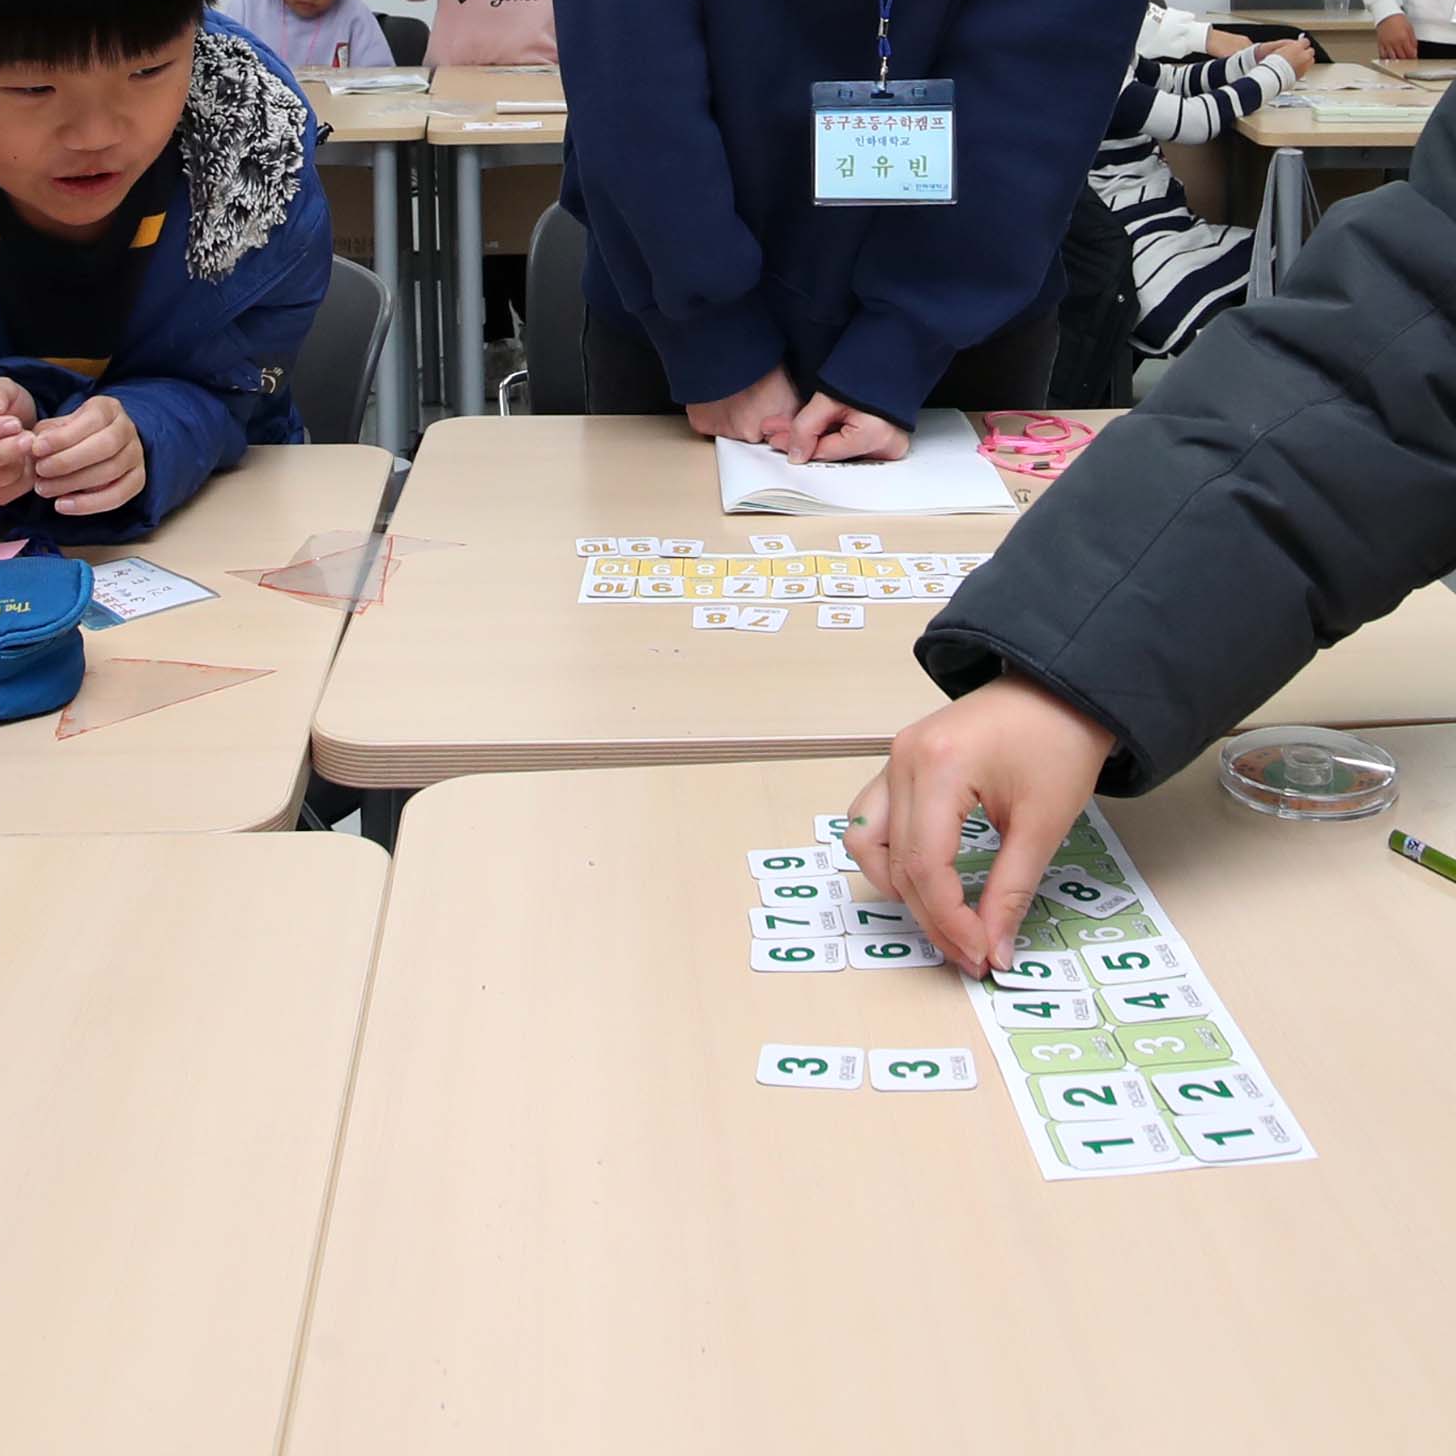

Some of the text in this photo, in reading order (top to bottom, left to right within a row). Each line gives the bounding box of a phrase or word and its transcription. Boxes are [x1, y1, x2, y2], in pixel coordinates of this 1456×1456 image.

[821, 115, 946, 131] 동구초등수학캠프
[855, 135, 911, 147] 인하대학교
[581, 544, 616, 553] 10
[672, 545, 692, 554] 8
[853, 541, 872, 550] 4
[599, 563, 633, 574] 10
[696, 564, 716, 575] 8
[830, 562, 848, 573] 5
[875, 564, 894, 575] 4
[914, 562, 935, 571] 3
[593, 583, 629, 593] 10
[695, 584, 715, 595] 8
[835, 583, 855, 592] 5
[880, 584, 900, 594] 4
[924, 583, 944, 593] 3
[5, 601, 32, 615] The
[705, 613, 727, 624] 8
[831, 613, 851, 624] 5
[774, 885, 819, 899] 8
[1059, 881, 1101, 902] 8
[765, 914, 810, 930] 7
[856, 909, 903, 925] 7
[1101, 952, 1150, 971] 5
[1008, 960, 1052, 979] 5
[1123, 992, 1170, 1009] 4
[1012, 1002, 1060, 1018] 4
[1031, 1043, 1083, 1062] 3
[1134, 1036, 1186, 1055] 3
[777, 1057, 828, 1076] 3
[888, 1060, 941, 1079] 3
[1062, 1085, 1118, 1107] 2
[1178, 1080, 1235, 1102] 2
[1202, 1128, 1255, 1145] 1
[1081, 1137, 1135, 1154] 1
